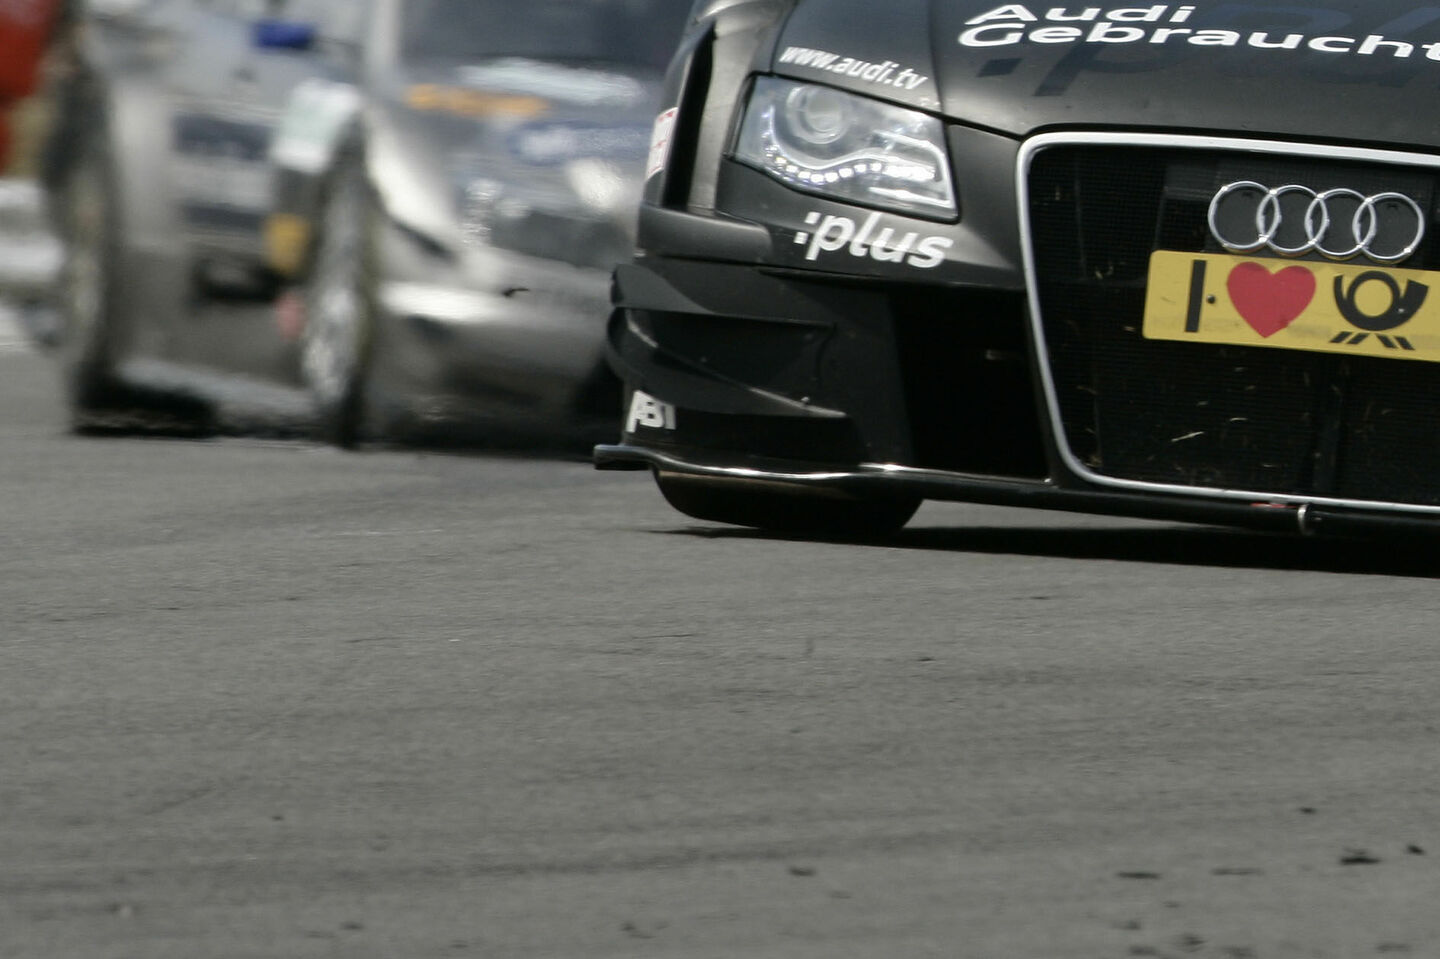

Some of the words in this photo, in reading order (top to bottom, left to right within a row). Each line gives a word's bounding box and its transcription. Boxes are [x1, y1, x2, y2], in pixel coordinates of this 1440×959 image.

[964, 4, 1197, 23] Audi
[779, 46, 928, 90] www.audi.tv
[793, 212, 954, 269] :plus
[1184, 259, 1207, 333] I
